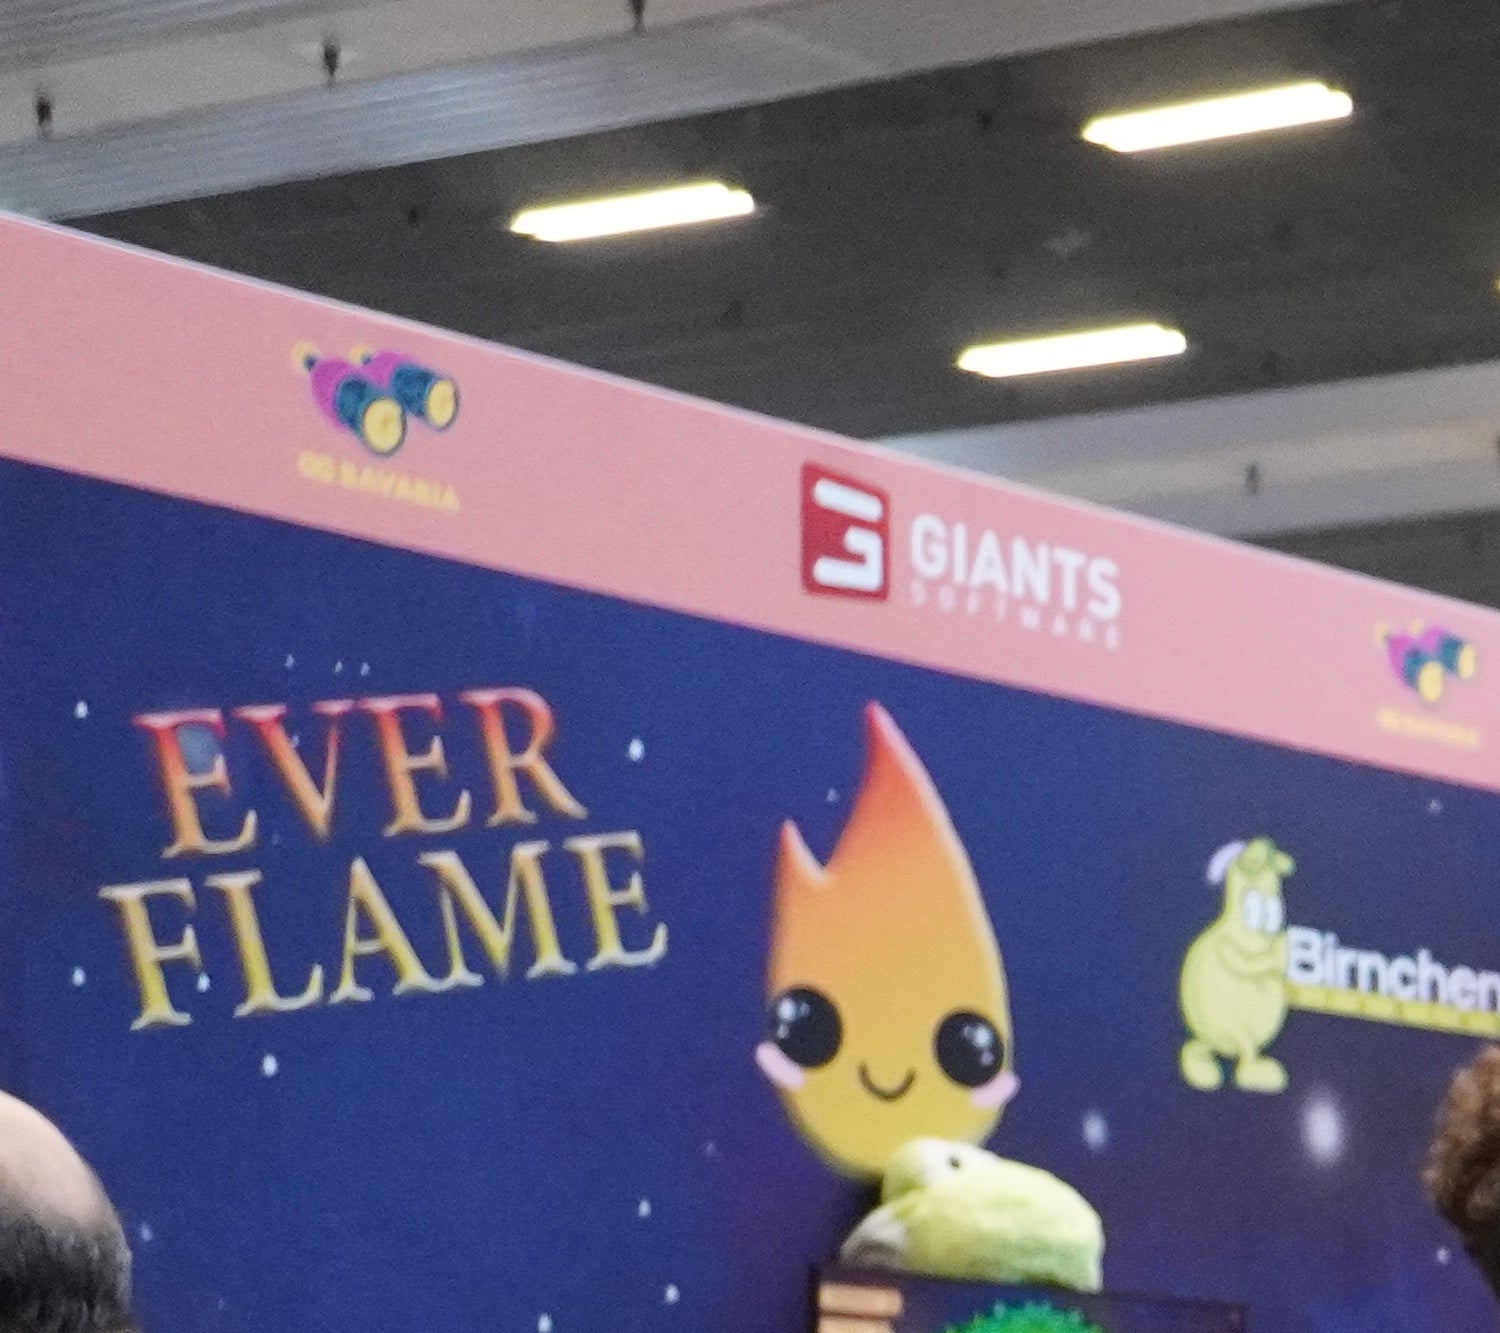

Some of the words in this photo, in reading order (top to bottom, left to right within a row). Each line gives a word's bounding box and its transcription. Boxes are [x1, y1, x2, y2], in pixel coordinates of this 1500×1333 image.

[909, 512, 1123, 622] GIANTS
[131, 685, 589, 859] EVER
[97, 829, 669, 1031] FLAME
